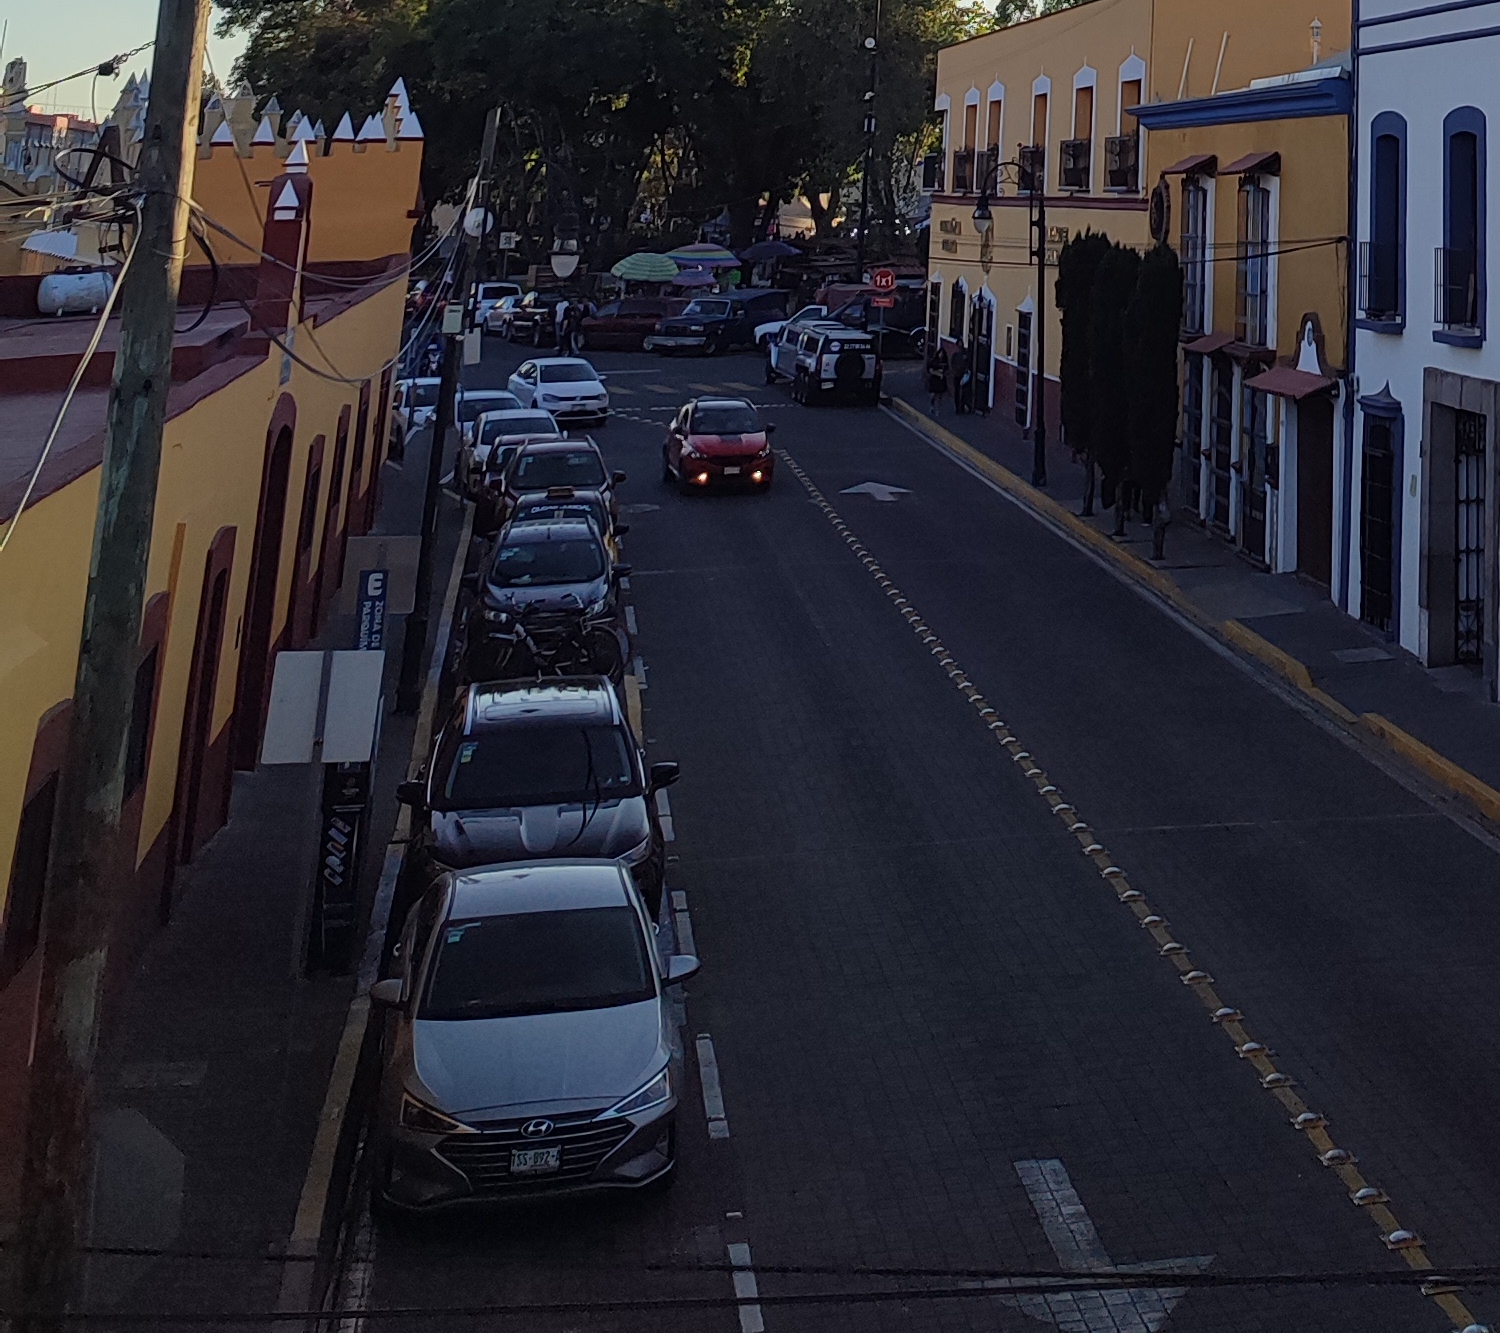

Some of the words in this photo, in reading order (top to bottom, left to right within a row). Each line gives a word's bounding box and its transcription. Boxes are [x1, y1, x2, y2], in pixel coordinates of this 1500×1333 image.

[874, 273, 892, 287] 1x1
[372, 600, 384, 632] ZONA
[371, 634, 381, 648] DE
